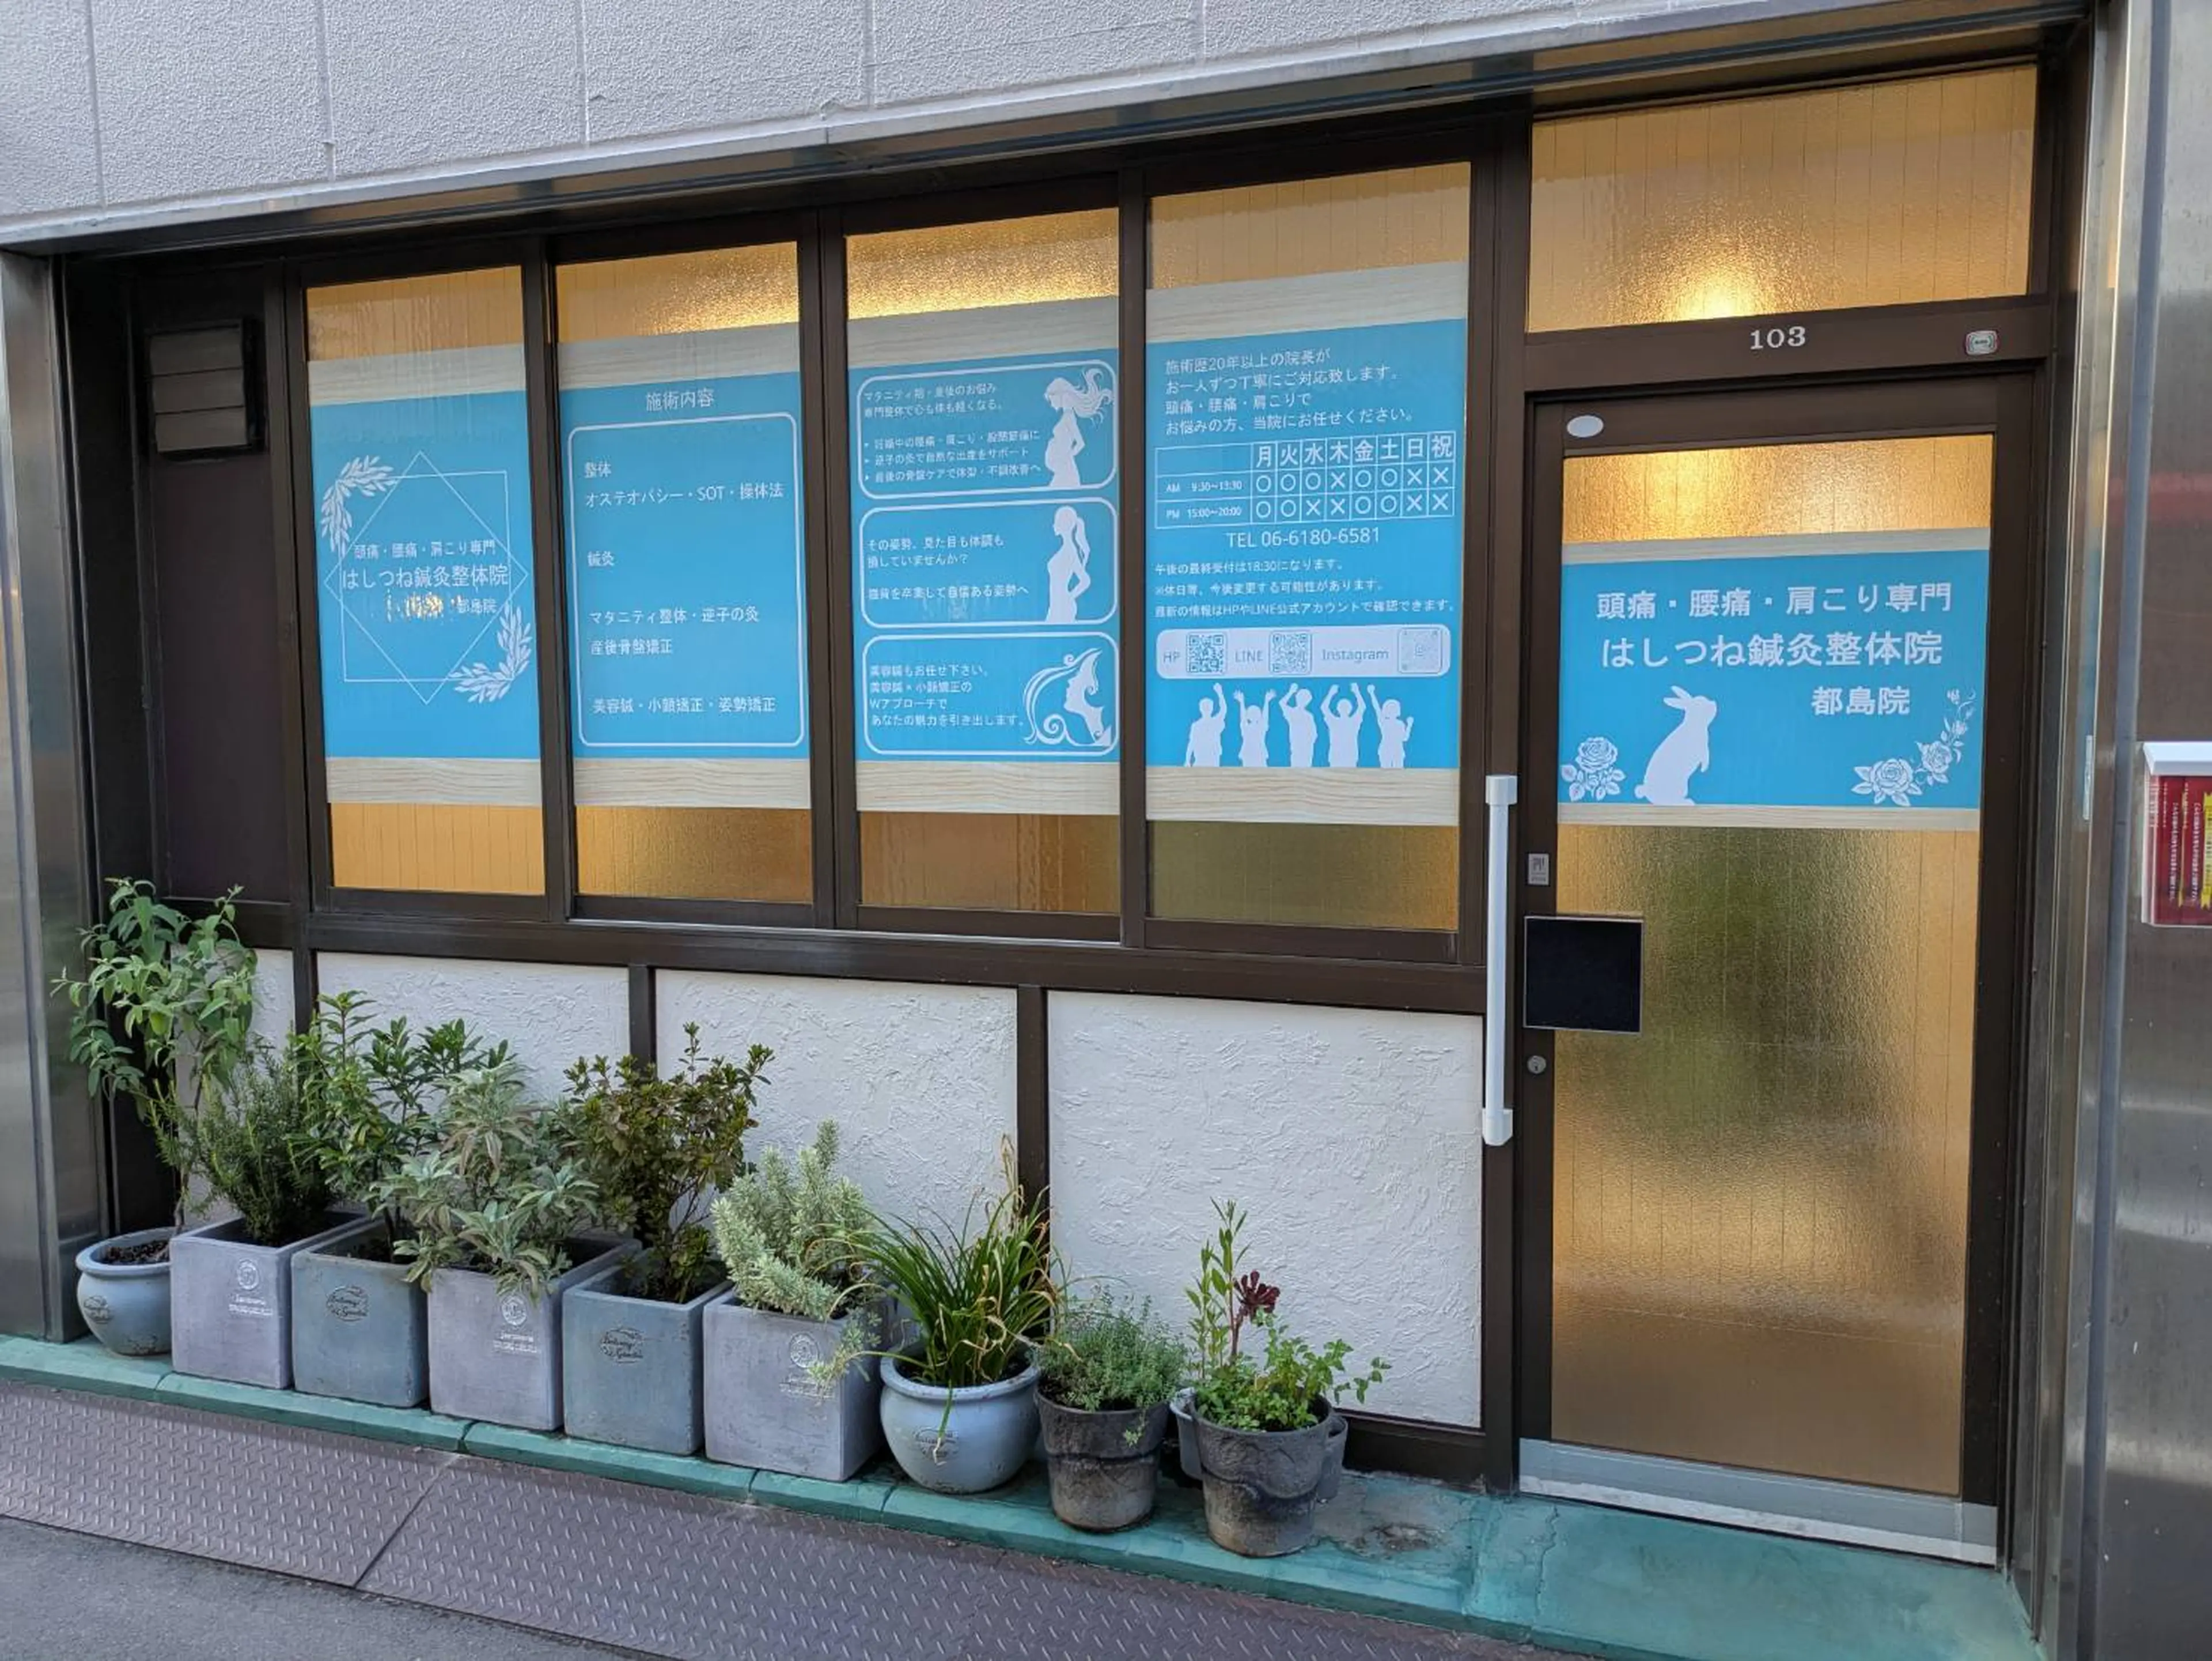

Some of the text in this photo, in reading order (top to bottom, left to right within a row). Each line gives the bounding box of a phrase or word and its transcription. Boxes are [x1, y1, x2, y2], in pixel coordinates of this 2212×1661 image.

[1749, 326, 1806, 350] 103
[1165, 347, 1331, 374] 施術歴20年以上の院長が
[1166, 365, 1399, 395] お一人ずつ丁寧にご対応致します。
[646, 388, 715, 411] 施術内容
[1166, 393, 1312, 414] 頭痛・腰痛・肩こりで
[1166, 408, 1414, 435] お悩みの方、当院にお任せください。
[1256, 434, 1453, 468] 月 火 水 木 金 土 日 祝
[585, 461, 611, 478] 整体
[1226, 527, 1380, 548] TEL 06-6180-6581
[343, 564, 508, 590] はしつね鍼灸整体院
[1597, 582, 1952, 619] 頭痛・腰痛・肩こり専門
[1163, 649, 1180, 665] HP
[1234, 648, 1264, 663] LINE
[1321, 648, 1389, 664] Instagram
[1603, 630, 1942, 668] はしつね鍼灸整体院
[1812, 686, 1910, 716] 都島院
